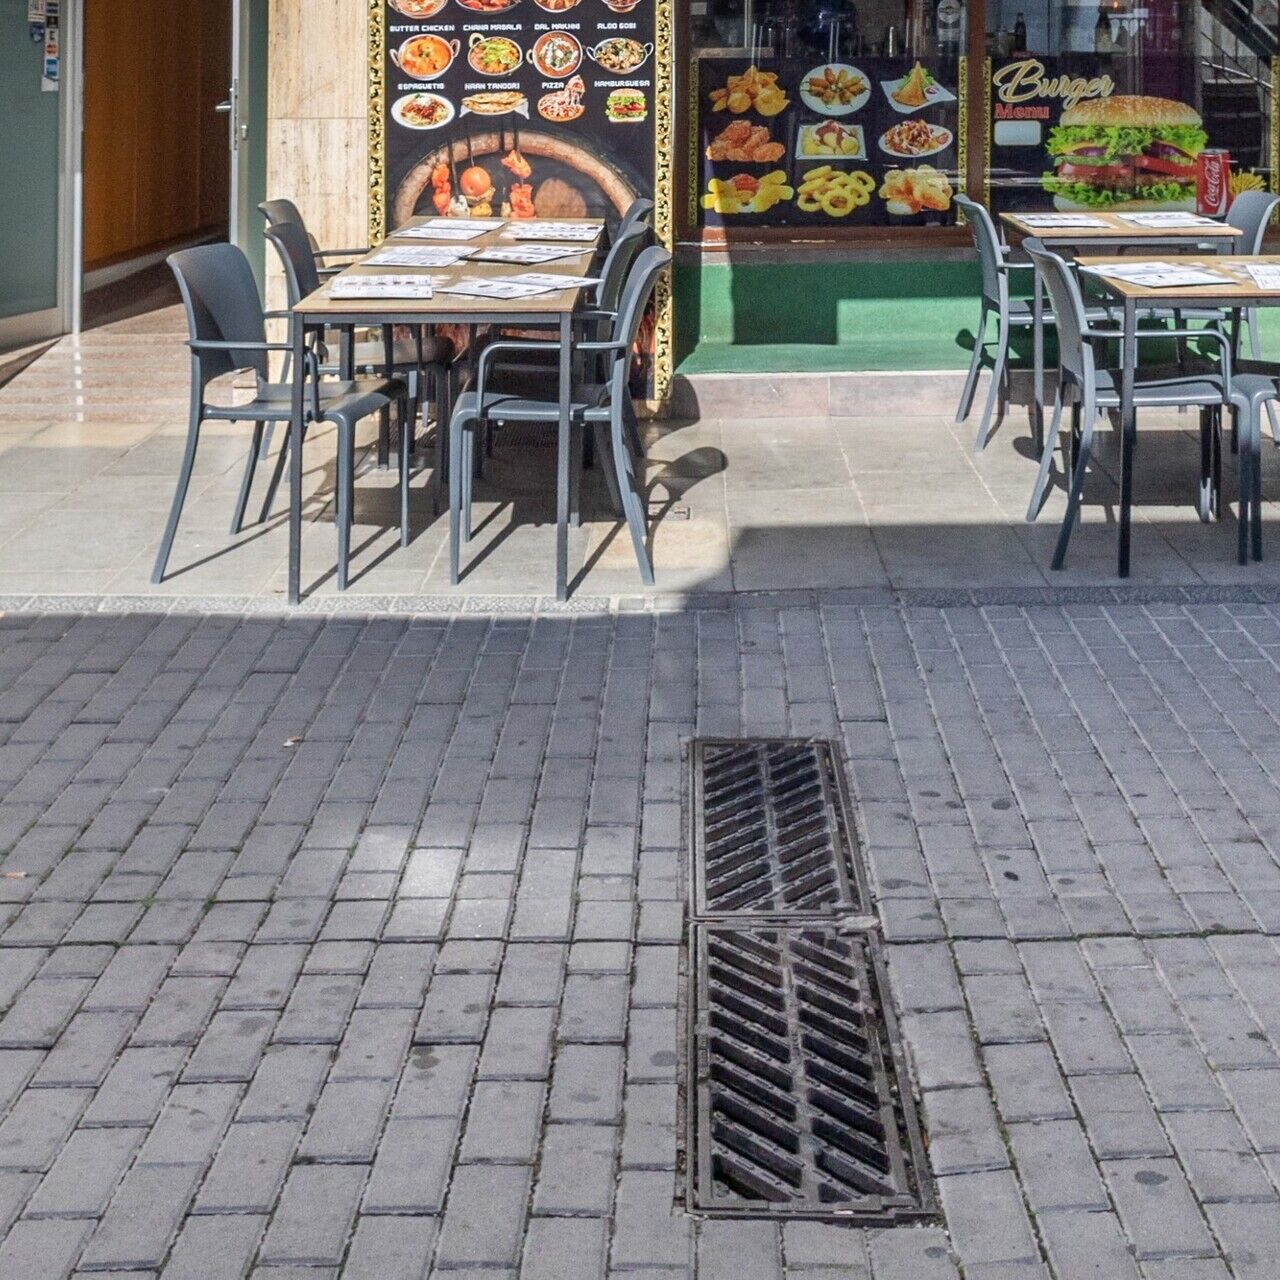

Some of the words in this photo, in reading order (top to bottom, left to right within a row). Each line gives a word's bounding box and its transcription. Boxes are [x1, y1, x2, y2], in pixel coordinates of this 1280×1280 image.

[541, 81, 565, 89] PIZZA
[992, 58, 1115, 110] Burger
[994, 103, 1050, 119] Menu
